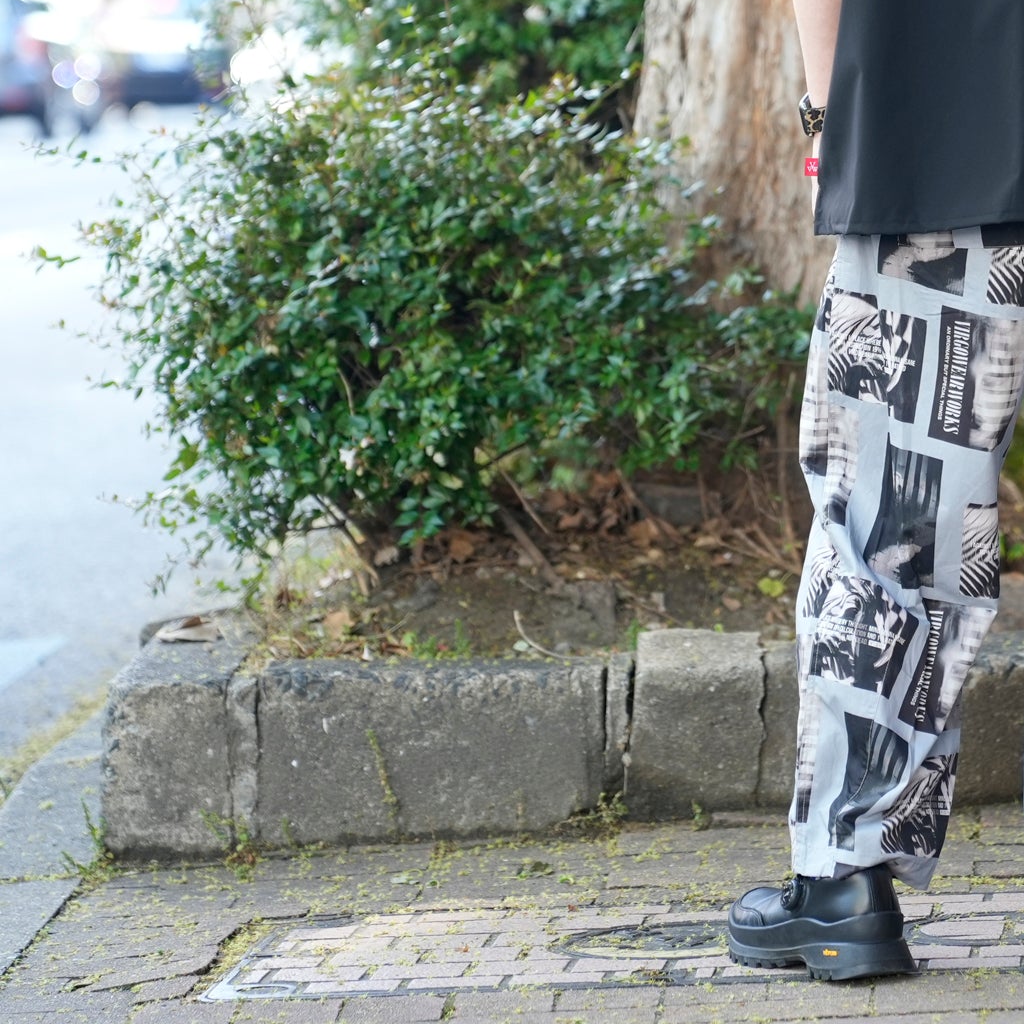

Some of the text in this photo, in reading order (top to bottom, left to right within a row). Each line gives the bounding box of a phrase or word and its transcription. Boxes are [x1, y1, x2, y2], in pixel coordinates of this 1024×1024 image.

[946, 326, 951, 335] AN
[943, 335, 951, 363] ORDINARY
[940, 376, 948, 399] SPECIAL
[943, 320, 971, 435] VIRGOWEARWORKS
[937, 399, 945, 420] THINGS
[910, 686, 920, 706] THINGS
